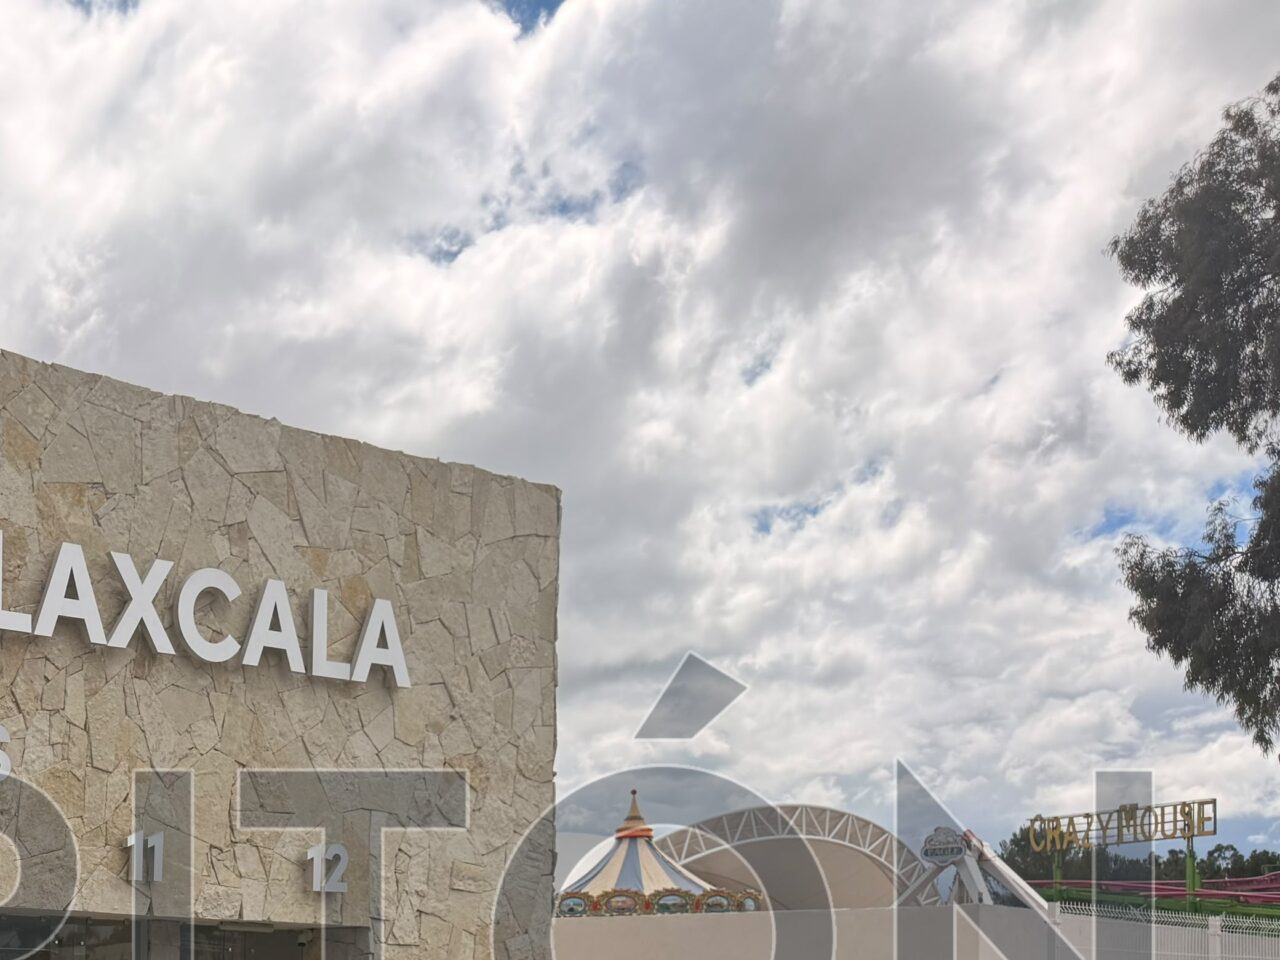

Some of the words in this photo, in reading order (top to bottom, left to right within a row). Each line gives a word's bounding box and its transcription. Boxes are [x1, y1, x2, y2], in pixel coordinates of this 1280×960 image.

[1028, 813, 1114, 852] CRAZY
[1116, 798, 1217, 845] MOUSE
[127, 829, 166, 882] 11
[306, 842, 350, 894] 12
